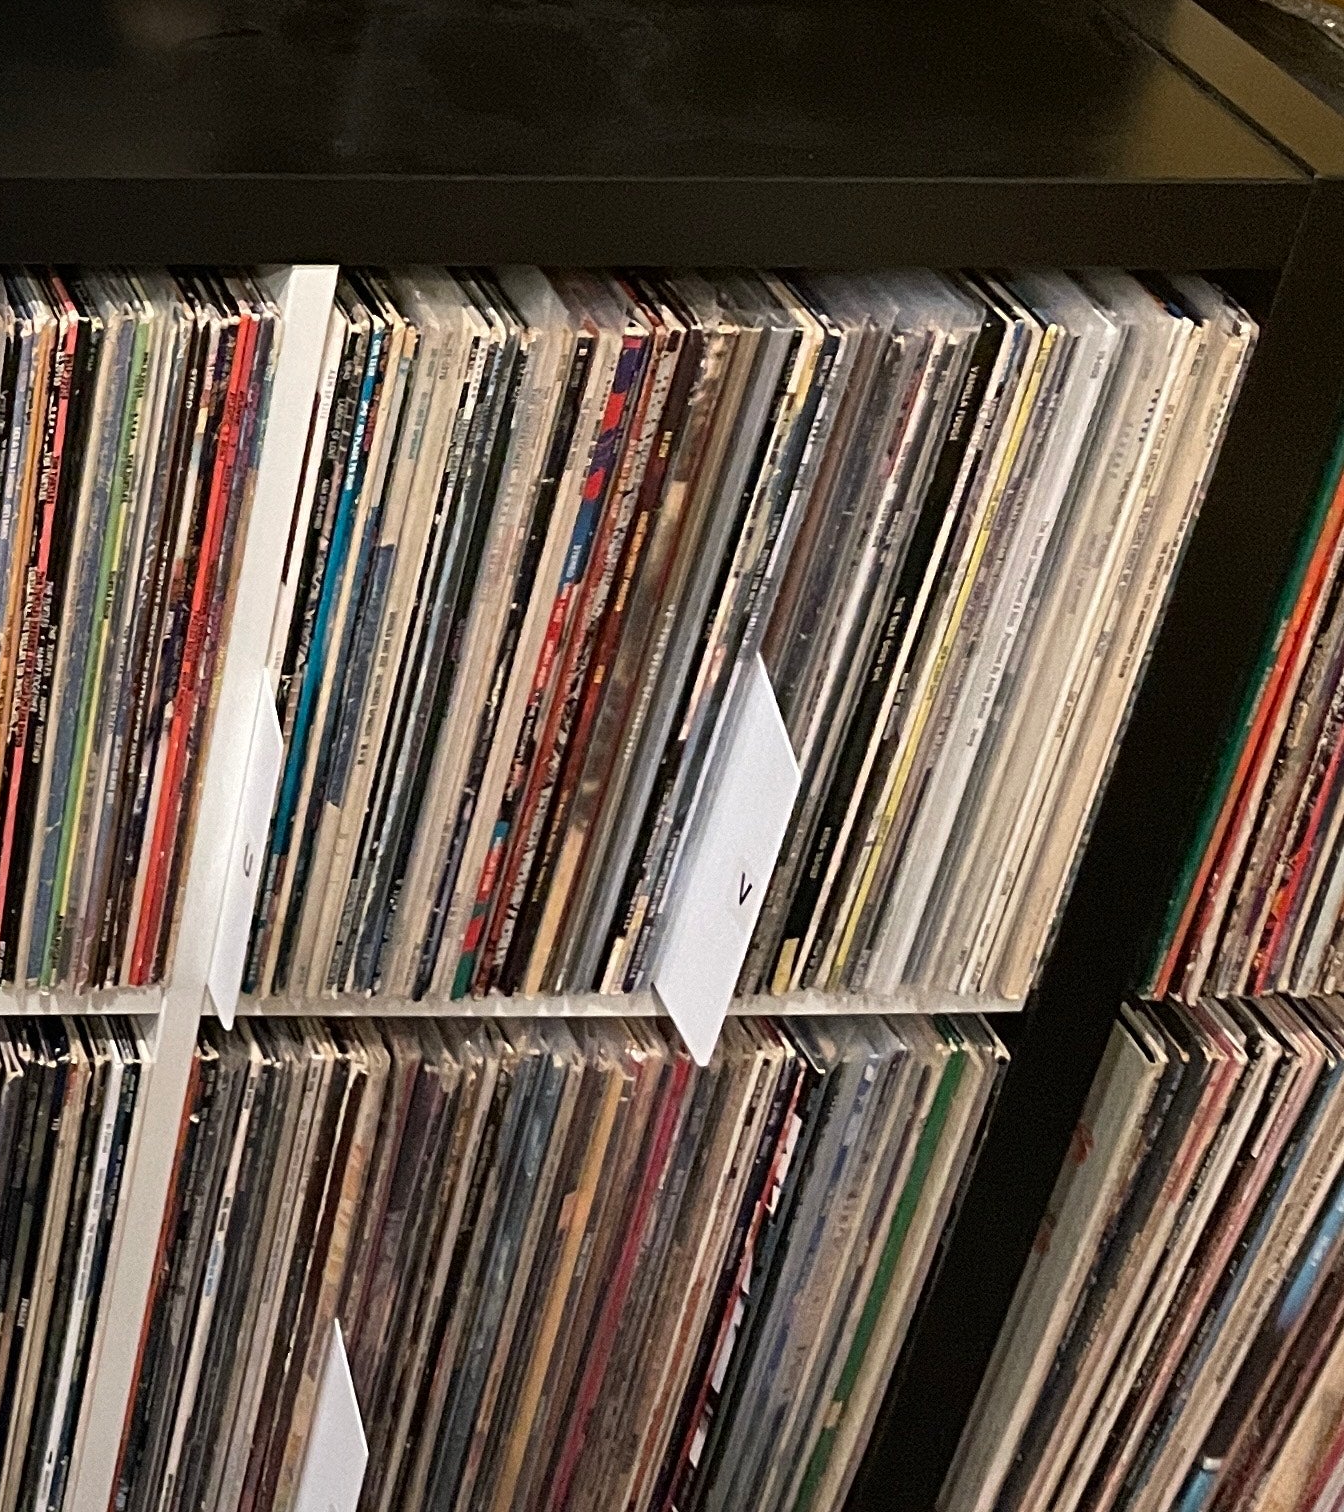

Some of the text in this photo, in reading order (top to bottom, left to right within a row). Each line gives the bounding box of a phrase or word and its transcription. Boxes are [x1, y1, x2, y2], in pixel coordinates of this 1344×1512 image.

[957, 365, 980, 407] VANILLA
[946, 409, 966, 441] FUDGE
[739, 870, 754, 907] V
